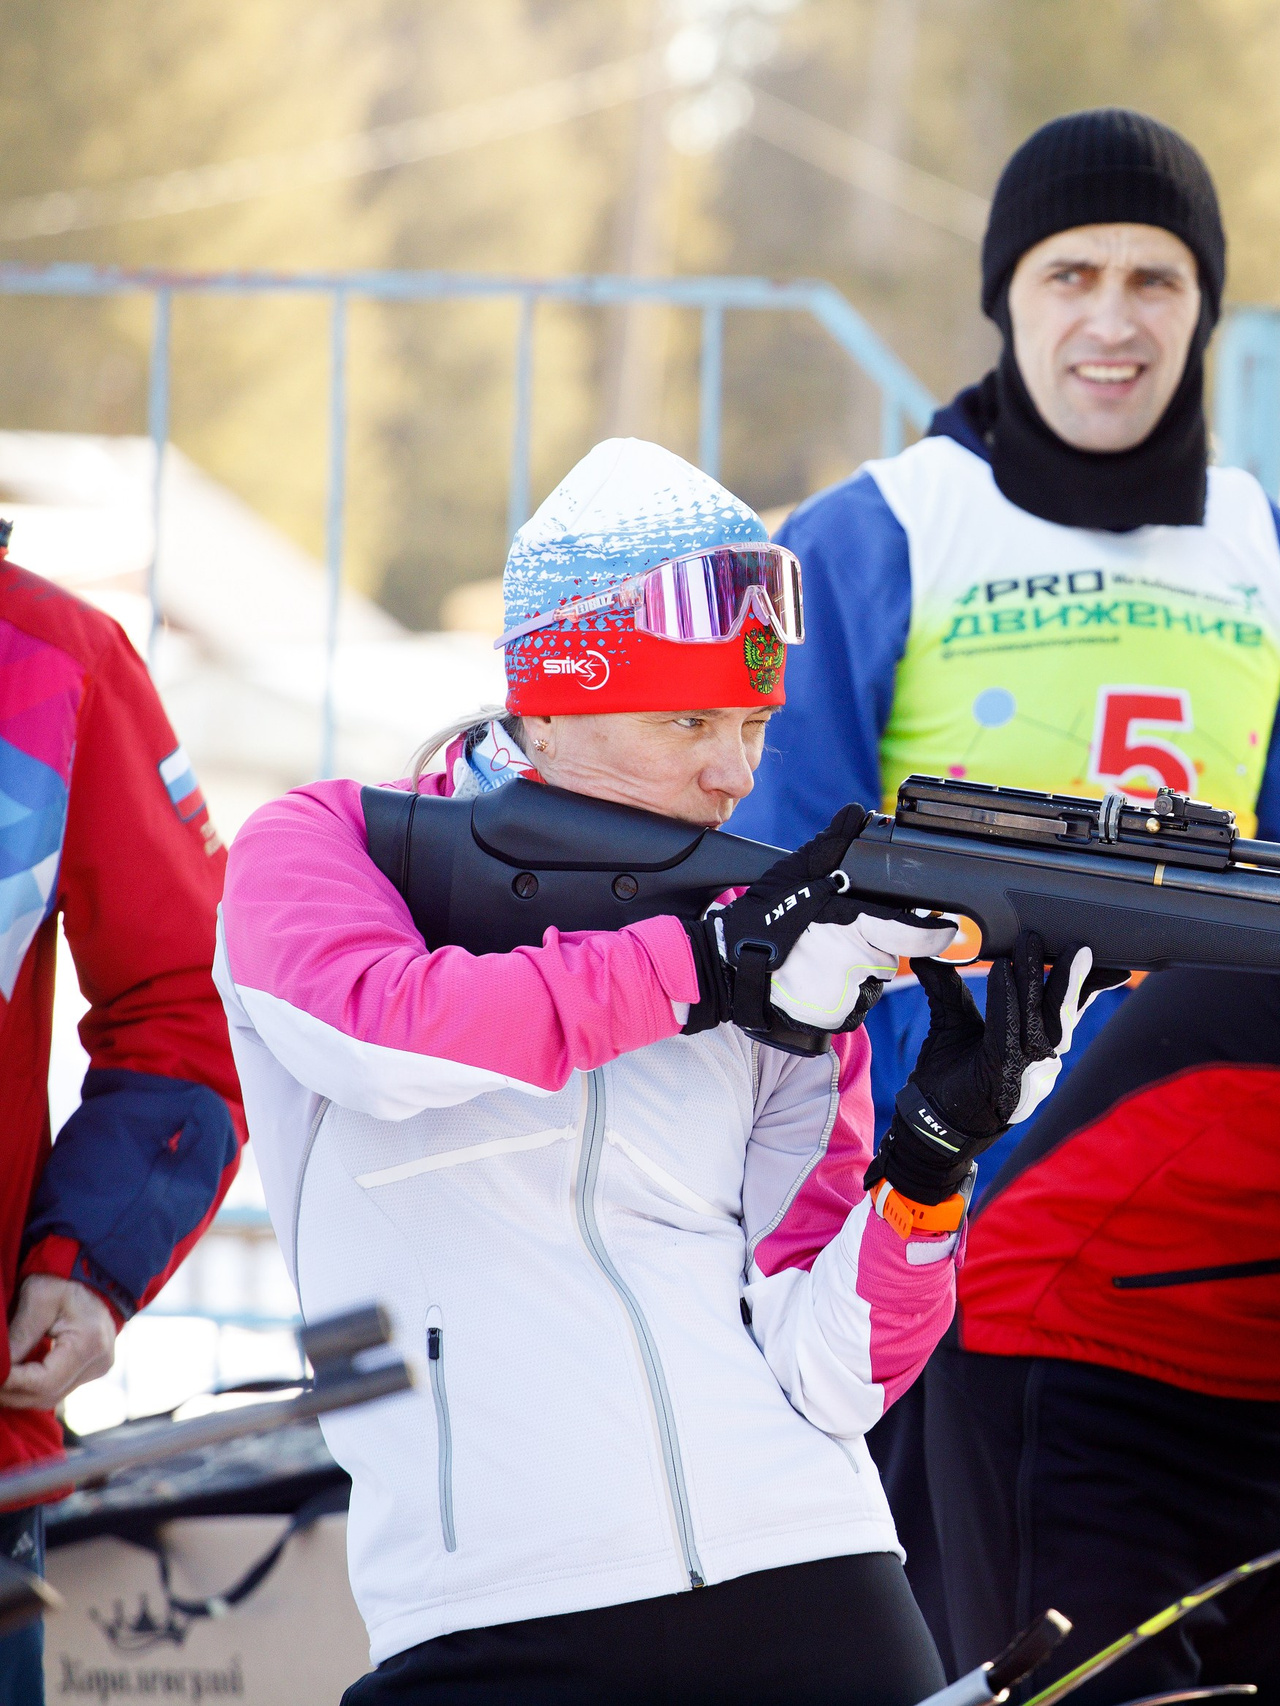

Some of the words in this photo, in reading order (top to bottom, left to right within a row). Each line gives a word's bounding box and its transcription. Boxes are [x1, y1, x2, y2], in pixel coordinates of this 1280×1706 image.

[1091, 687, 1193, 804] 5
[764, 886, 811, 926] LEKI
[918, 1108, 948, 1136] LEKI
